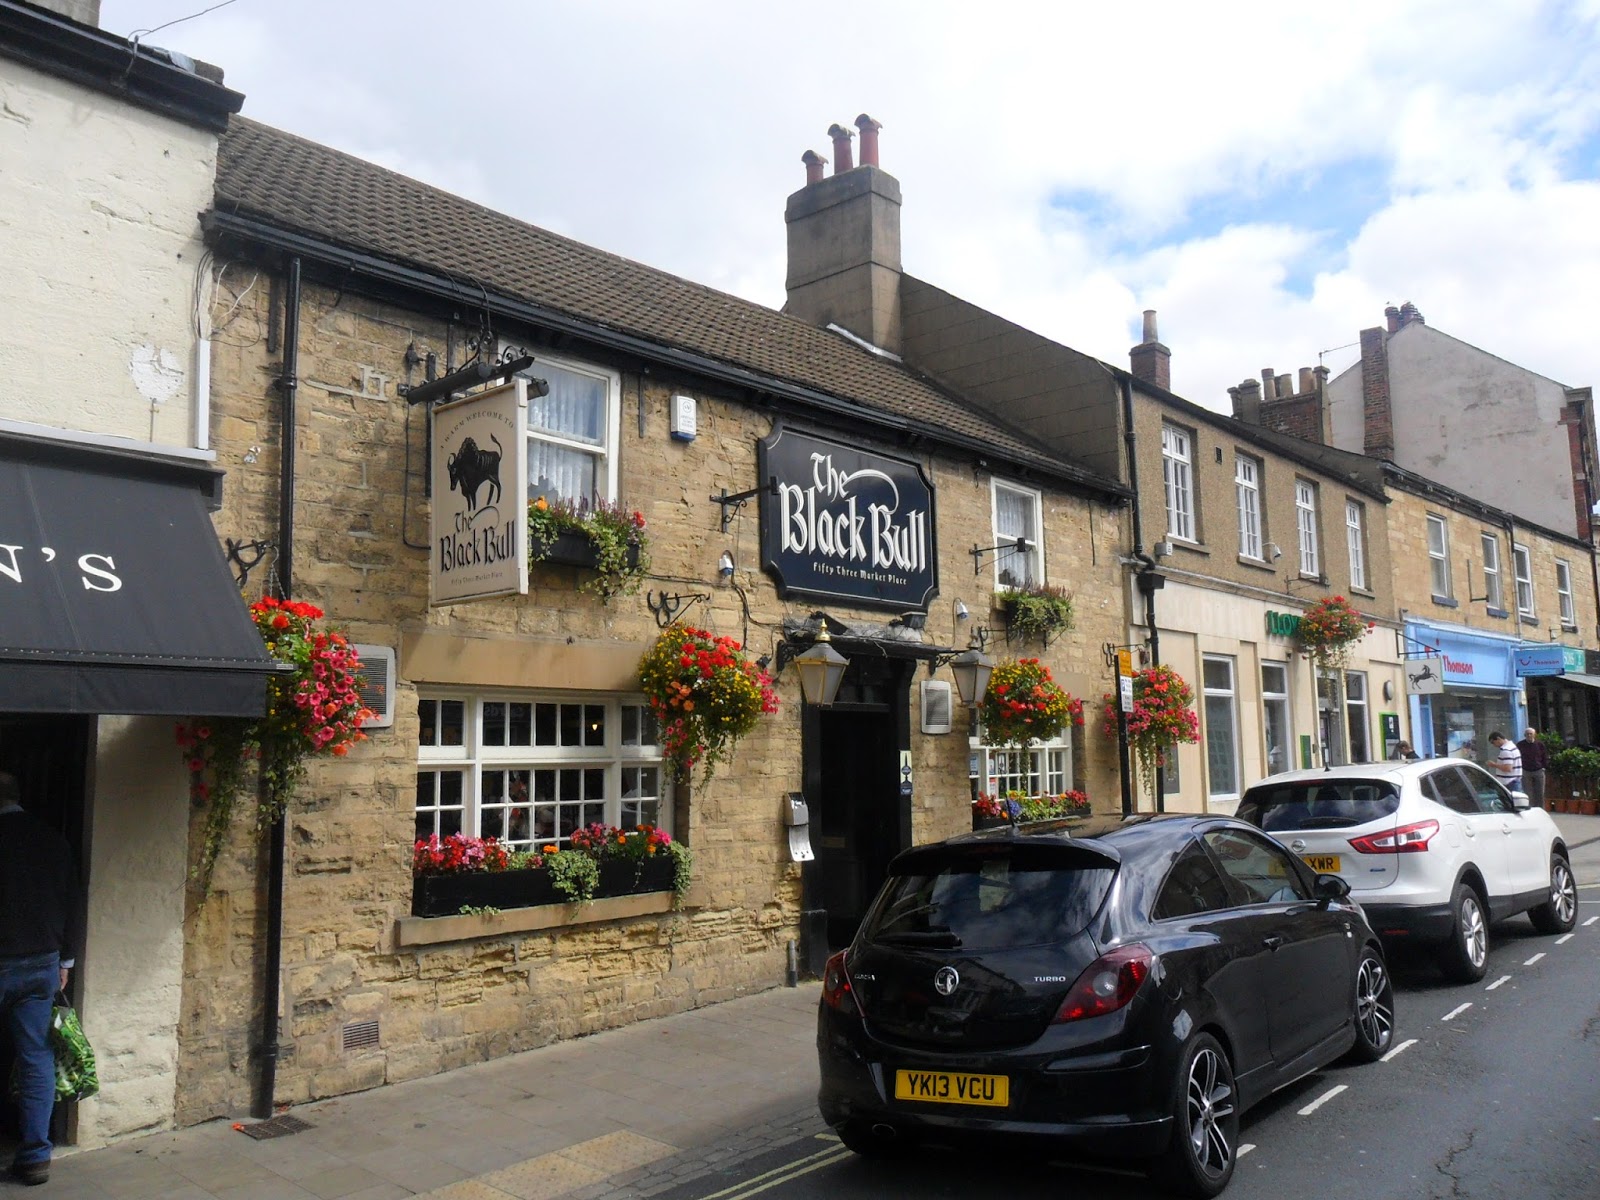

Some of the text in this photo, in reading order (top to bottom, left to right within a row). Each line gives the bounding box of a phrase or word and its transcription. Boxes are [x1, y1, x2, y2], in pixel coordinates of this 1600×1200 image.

[466, 411, 503, 421] WELCOME
[504, 417, 515, 429] TO
[810, 452, 851, 502] The
[778, 482, 926, 574] Black Bull
[440, 520, 516, 573] Black Bull
[813, 562, 907, 586] Fifty Three Market Place
[1442, 655, 1474, 675] Thomson
[1309, 858, 1334, 870] XWR
[908, 1073, 995, 1101] YK13 VCU
